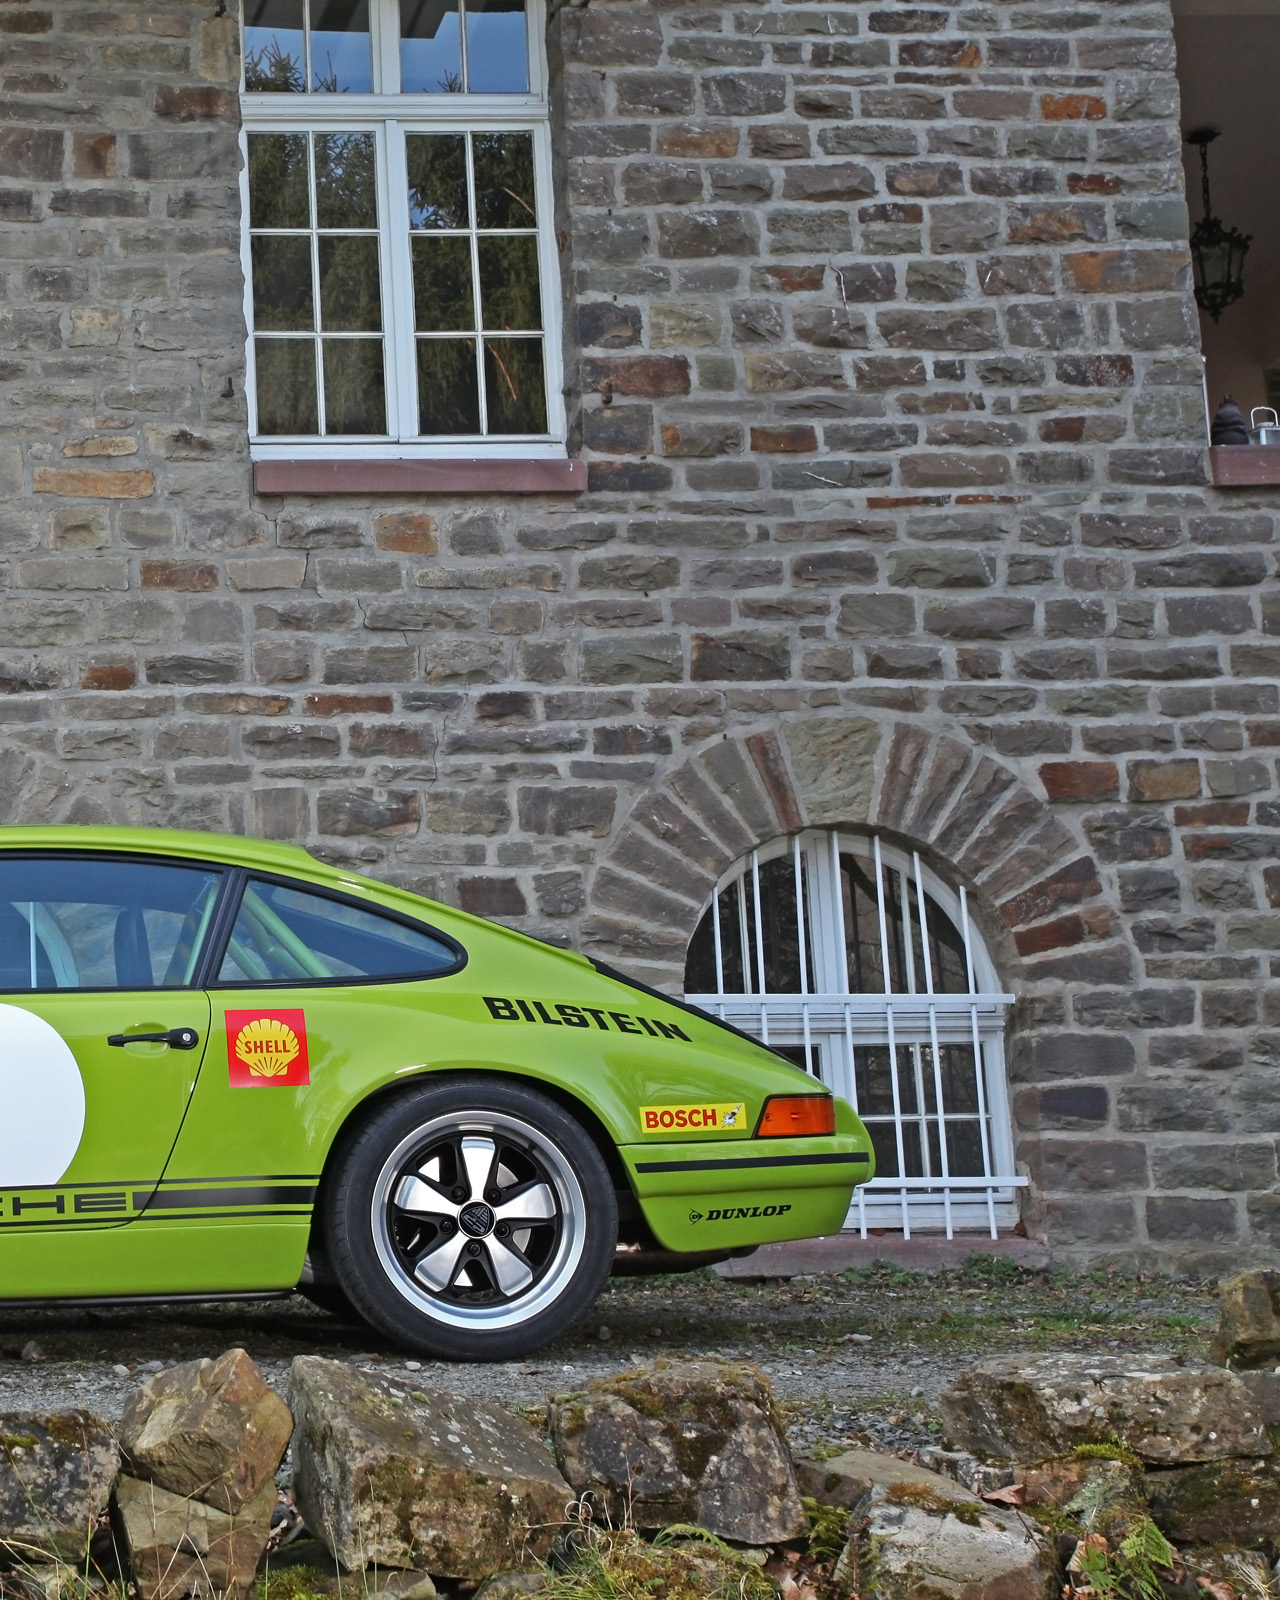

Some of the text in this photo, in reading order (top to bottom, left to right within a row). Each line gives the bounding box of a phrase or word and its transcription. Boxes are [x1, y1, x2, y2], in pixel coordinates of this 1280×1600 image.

[482, 996, 693, 1043] BILSTEIN
[244, 1040, 291, 1054] SHELL
[645, 1109, 717, 1129] BOSCH
[705, 1205, 792, 1221] DUNLOP
